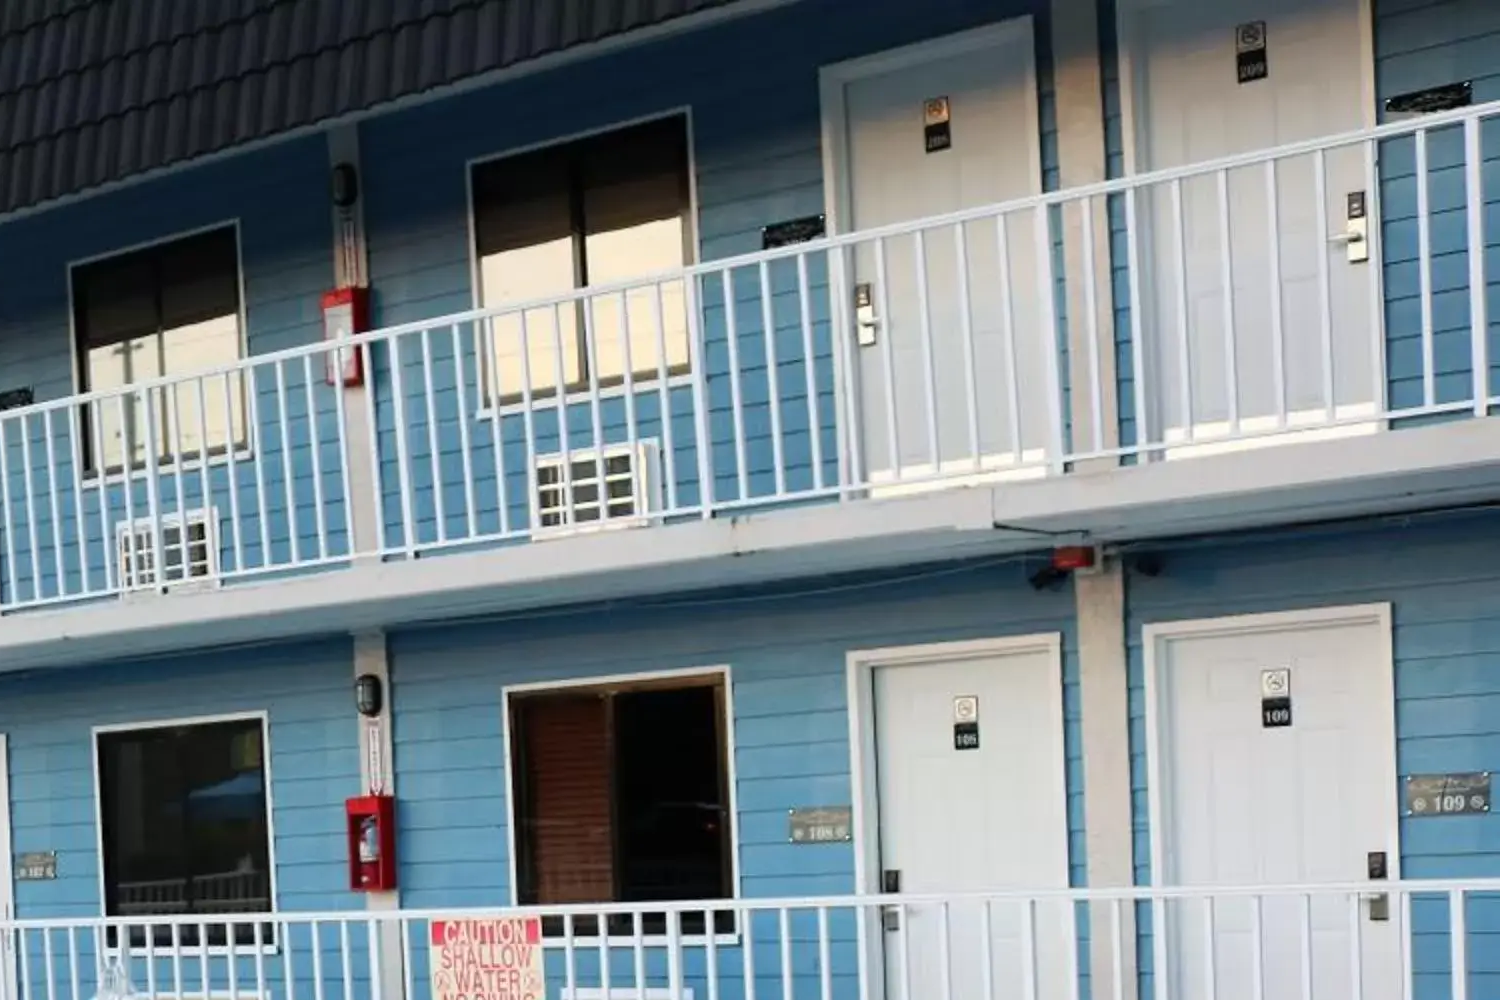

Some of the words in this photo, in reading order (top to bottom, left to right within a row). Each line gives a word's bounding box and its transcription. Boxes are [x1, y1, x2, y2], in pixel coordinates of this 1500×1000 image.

[1266, 710, 1289, 722] 109
[1434, 795, 1465, 812] 109
[443, 919, 525, 944] CAUTION
[441, 943, 533, 969] SHALLOW
[455, 969, 520, 993] WATER
